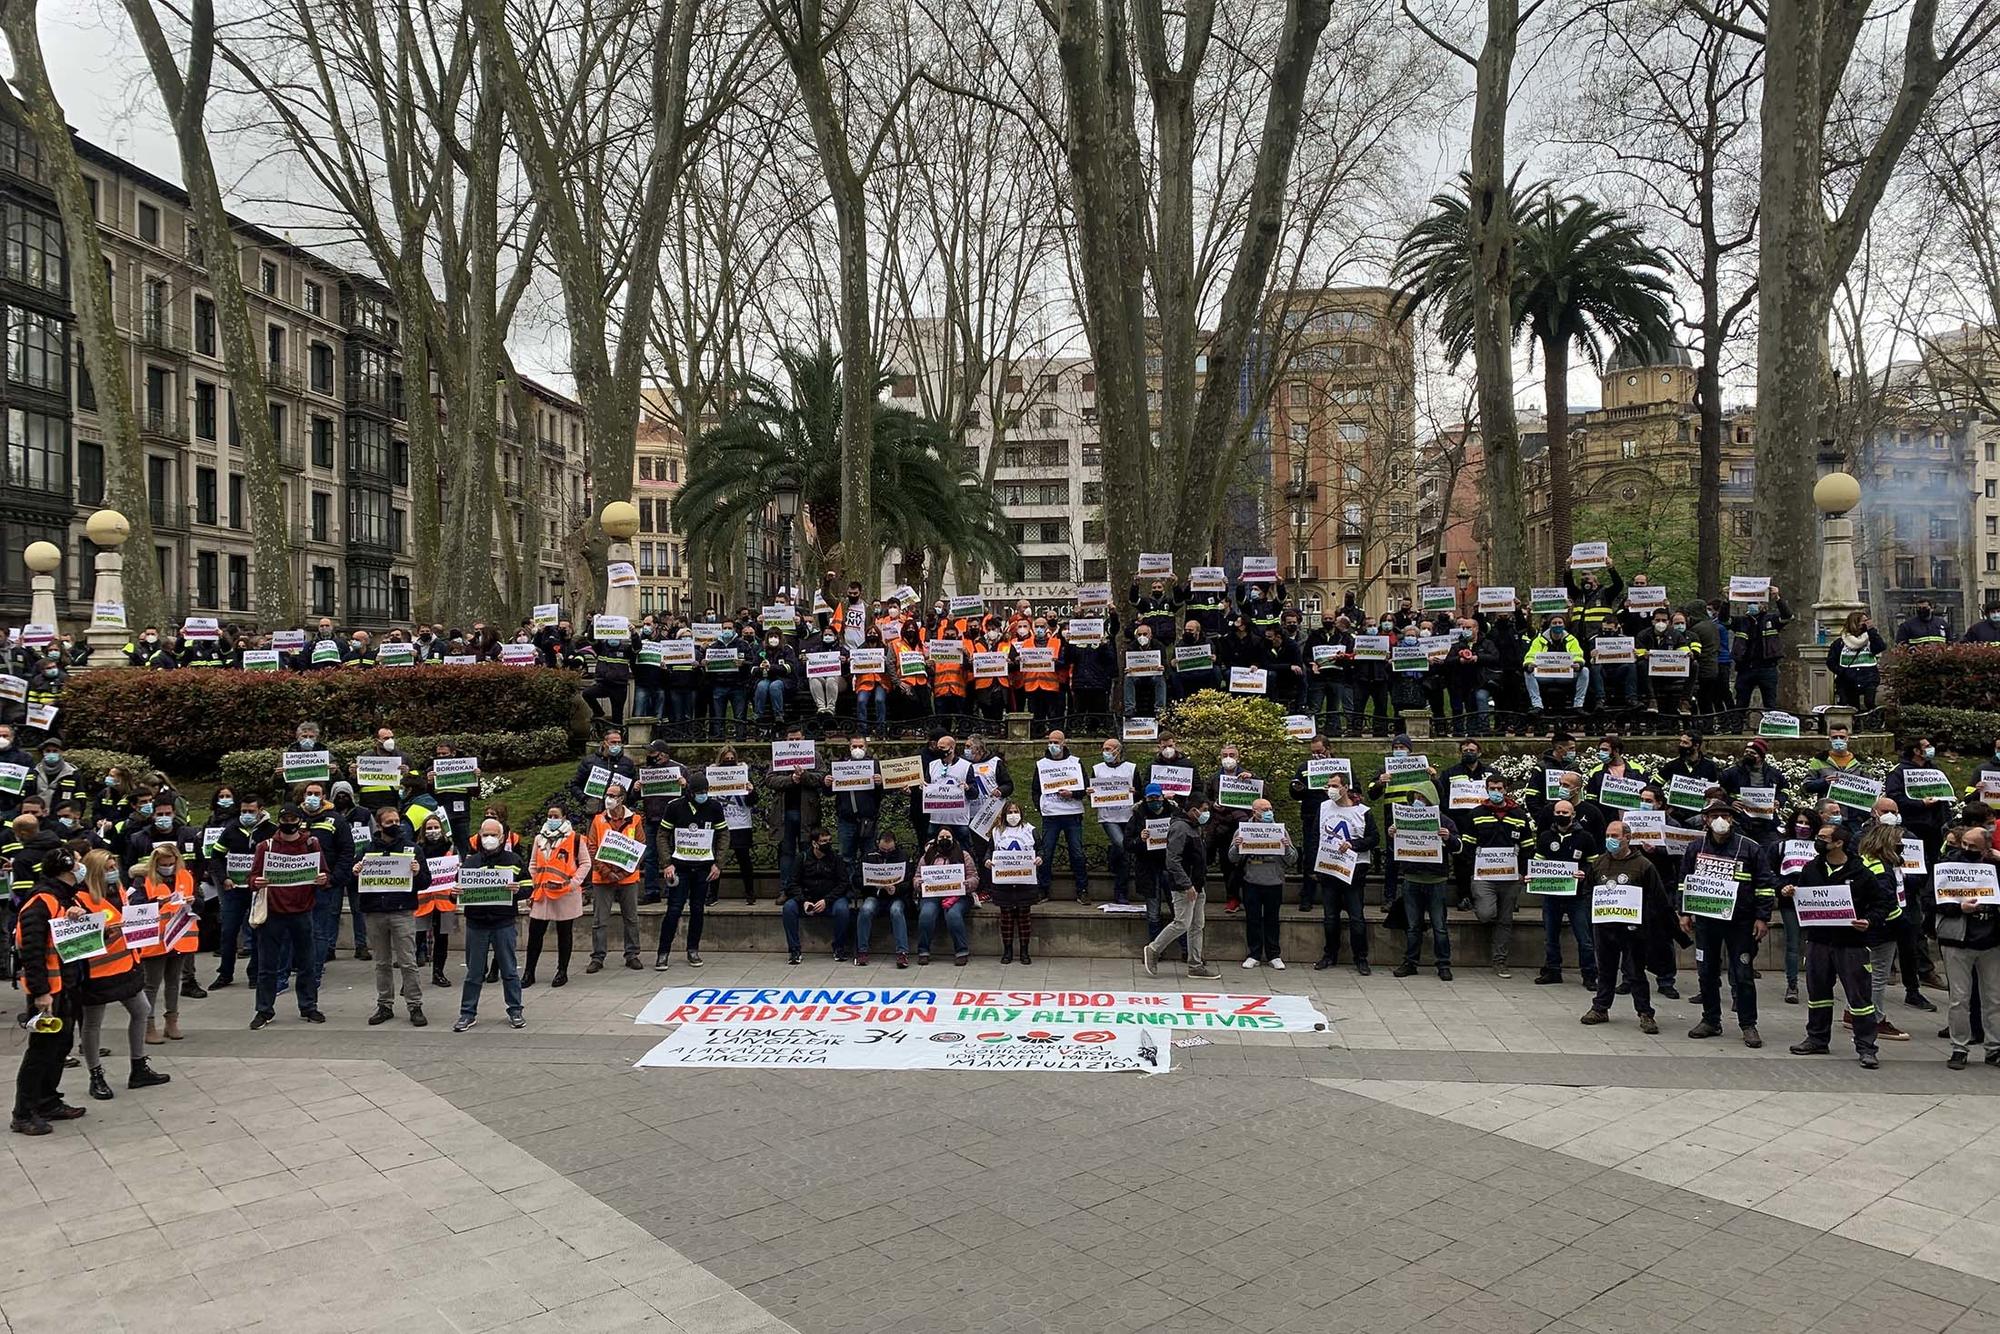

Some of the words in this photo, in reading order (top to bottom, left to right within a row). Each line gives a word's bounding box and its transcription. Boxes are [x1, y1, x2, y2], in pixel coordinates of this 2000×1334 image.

[1152, 774, 1192, 783] Administración
[1835, 771, 1871, 785] Langileok
[1222, 782, 1259, 794] BORROKAN
[1605, 782, 1641, 793] BORROKA
[1673, 783, 1705, 792] BORROK
[1834, 779, 1877, 794] BORROKAN
[1395, 811, 1435, 819] BORROKAN
[605, 839, 639, 855] BORROKAN
[268, 854, 306, 862] Langileok
[1696, 858, 1735, 869] TUBACEX
[1531, 861, 1565, 869] Langileok
[1707, 865, 1734, 875] SALBA
[1531, 868, 1574, 876] BORROKAN
[1687, 876, 1725, 888] Langileok
[1687, 885, 1733, 897] BORROKAN
[1798, 899, 1851, 907] Administración
[54, 923, 99, 937] BORROKAN
[684, 988, 937, 1005] AERNNOVA
[1181, 994, 1276, 1015] EZ
[664, 1005, 937, 1023] READMISION
[957, 1007, 1021, 1022] HAY
[1031, 1011, 1286, 1029] ALTERNATIVAS
[704, 1028, 828, 1037] TUBACEX
